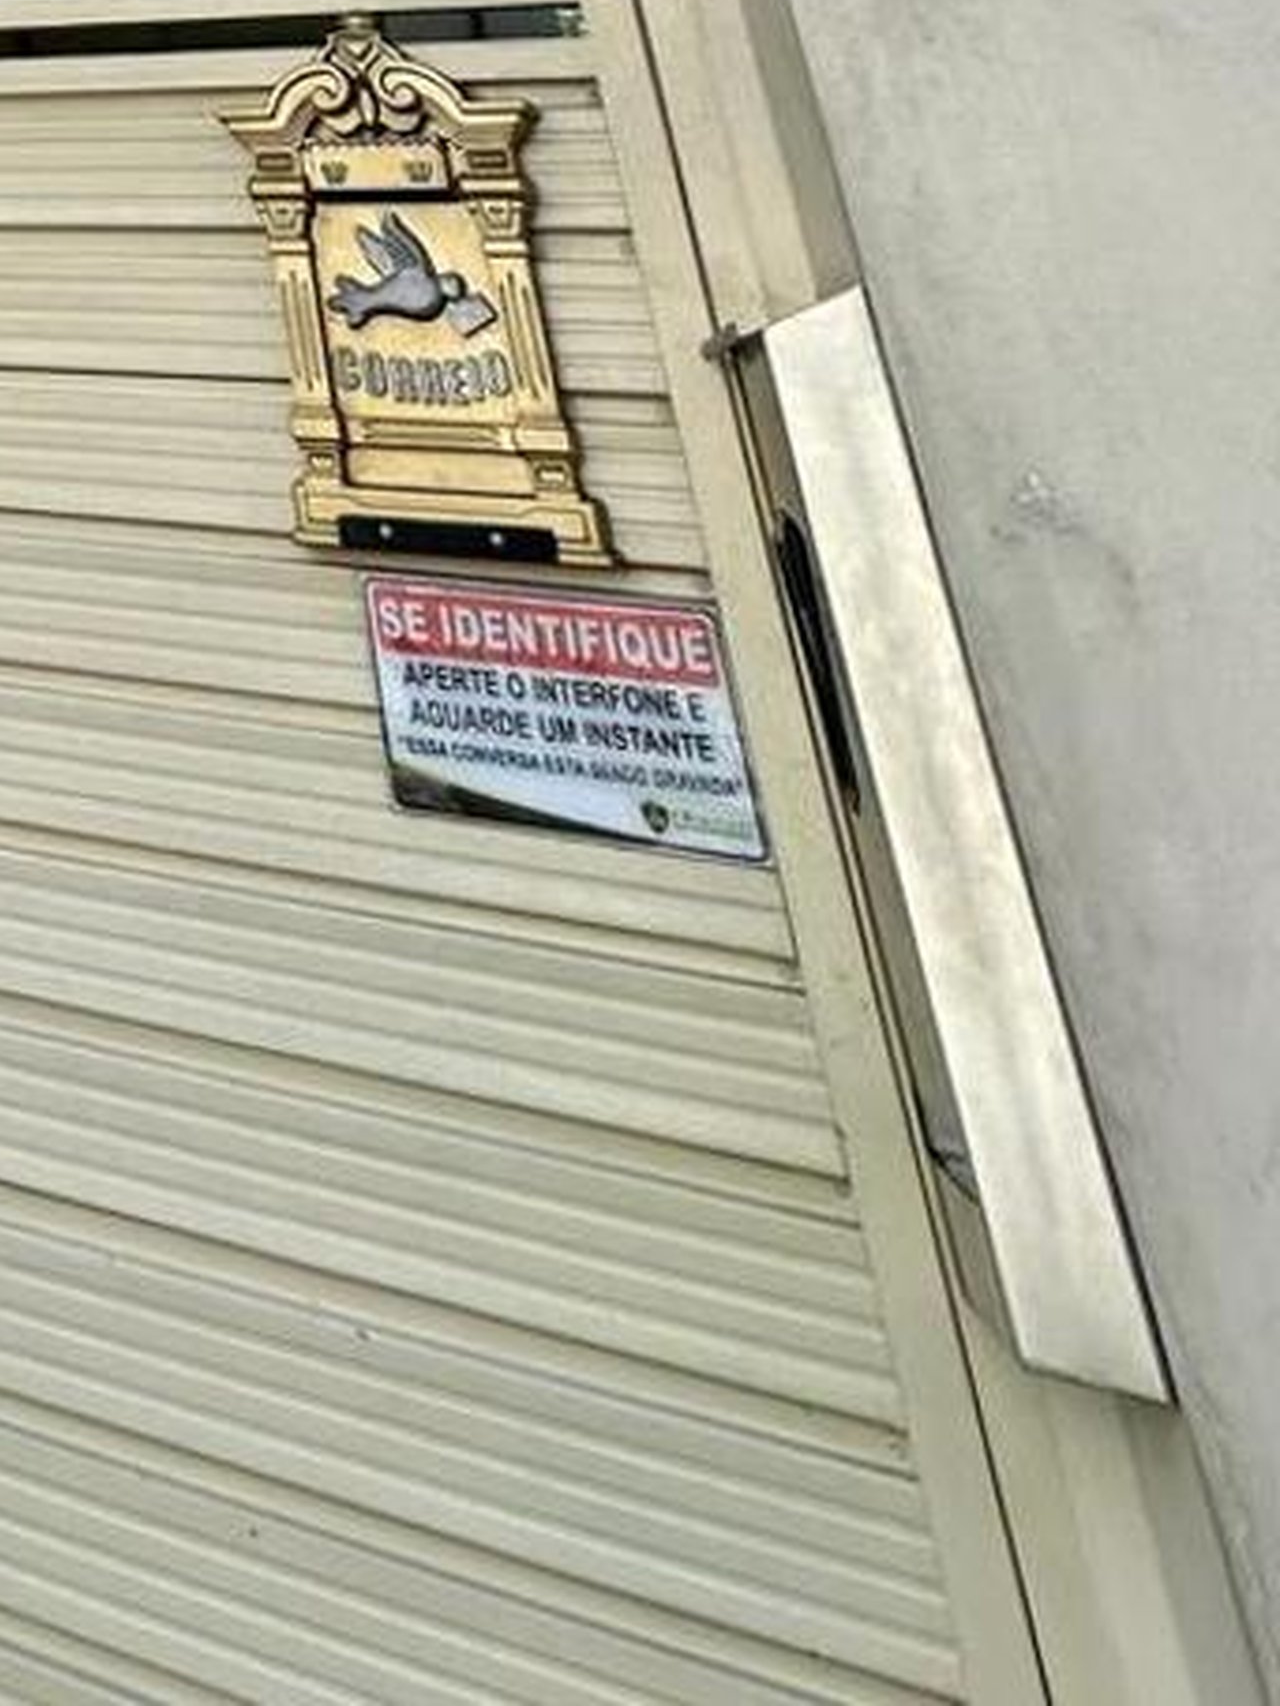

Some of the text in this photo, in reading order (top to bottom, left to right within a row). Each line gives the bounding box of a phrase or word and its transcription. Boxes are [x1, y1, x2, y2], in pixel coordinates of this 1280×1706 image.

[334, 347, 512, 405] CORREIO
[378, 598, 714, 675] SE IDENTIFIQUE
[402, 661, 708, 722] APERTE O INTERFONE E
[409, 701, 717, 763] AGUARDE UM INSTANTE
